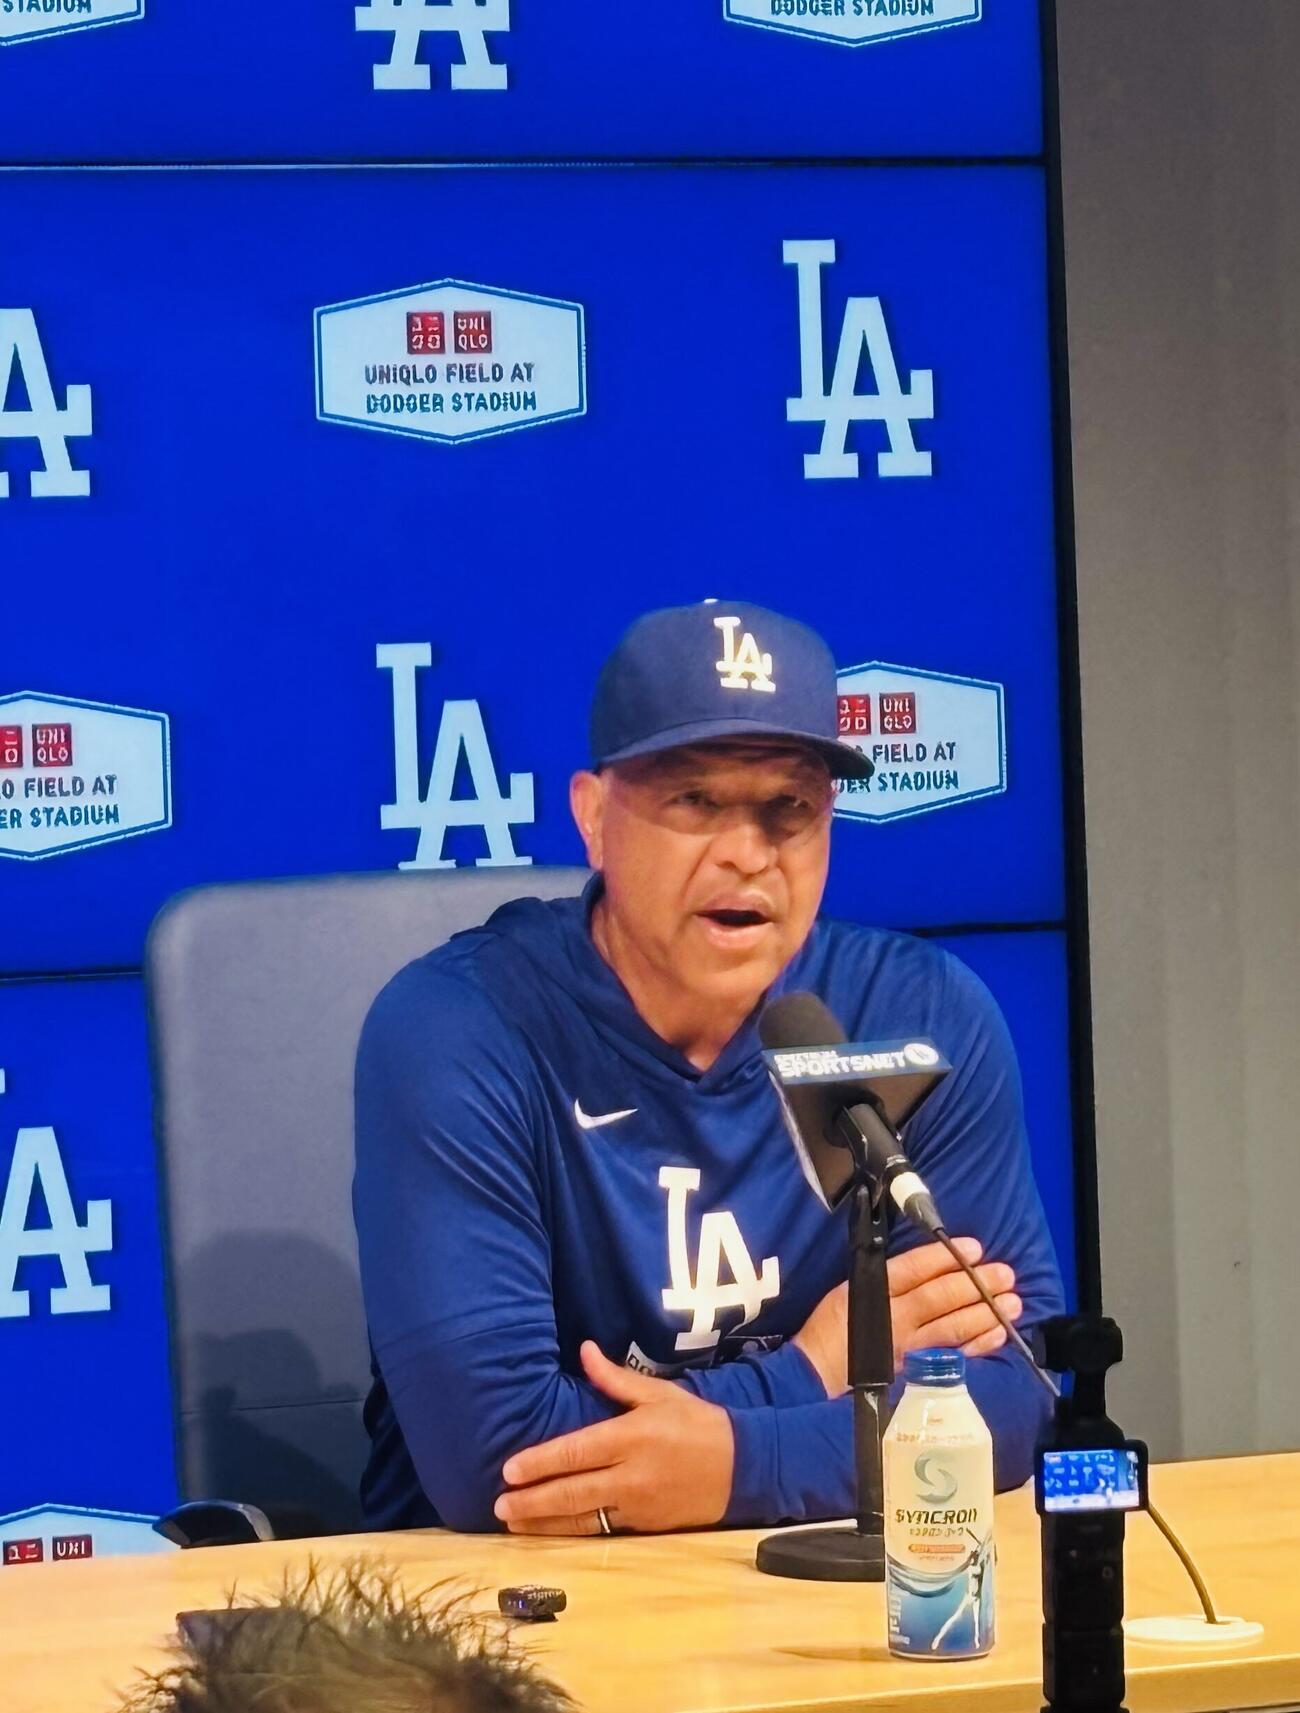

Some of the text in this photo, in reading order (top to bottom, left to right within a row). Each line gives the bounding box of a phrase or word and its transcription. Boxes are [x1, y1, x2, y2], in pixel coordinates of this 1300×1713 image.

[783, 239, 934, 479] LA
[364, 361, 536, 387] UNIQLO FIELD AT
[366, 390, 537, 414] DODGER STADIUM
[713, 616, 776, 693] LA
[375, 641, 535, 870] LA
[872, 741, 956, 763] FIELD AT
[24, 775, 85, 799] FIELD
[92, 773, 118, 796] AT
[878, 769, 959, 793] STADIUM
[29, 803, 120, 829] STADIUM
[658, 1166, 781, 1351] LA
